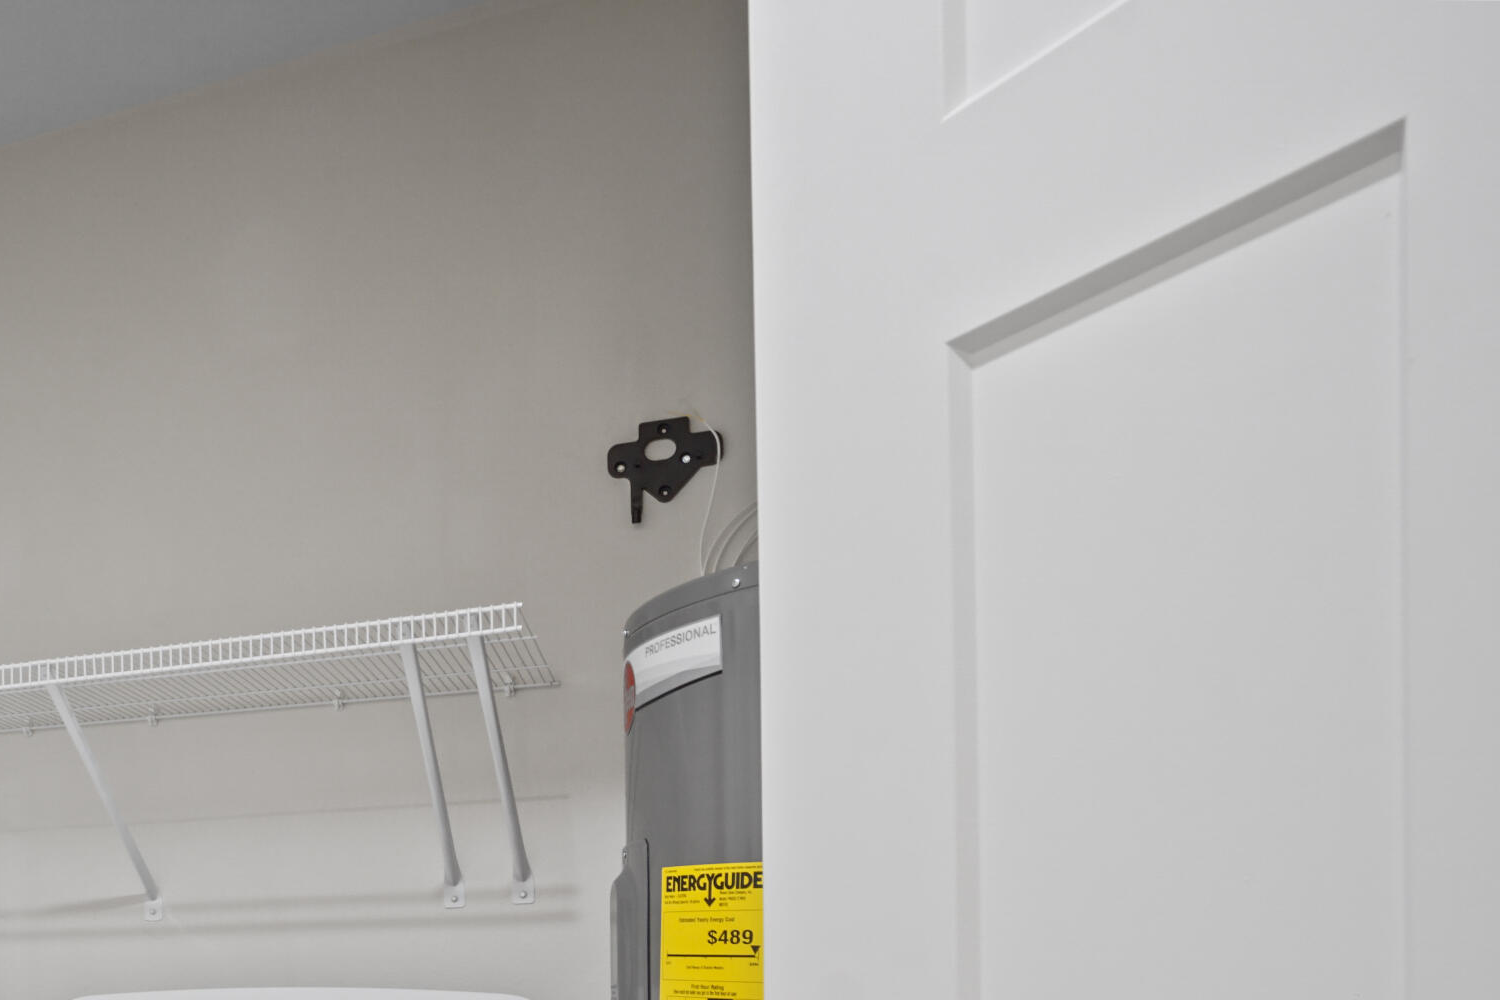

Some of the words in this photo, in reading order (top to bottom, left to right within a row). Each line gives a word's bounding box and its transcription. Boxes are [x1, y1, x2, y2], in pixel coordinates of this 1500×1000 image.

[644, 623, 717, 657] PROFESSIONAL
[665, 870, 763, 893] ENERGYGUIDE
[707, 929, 754, 946] $489
